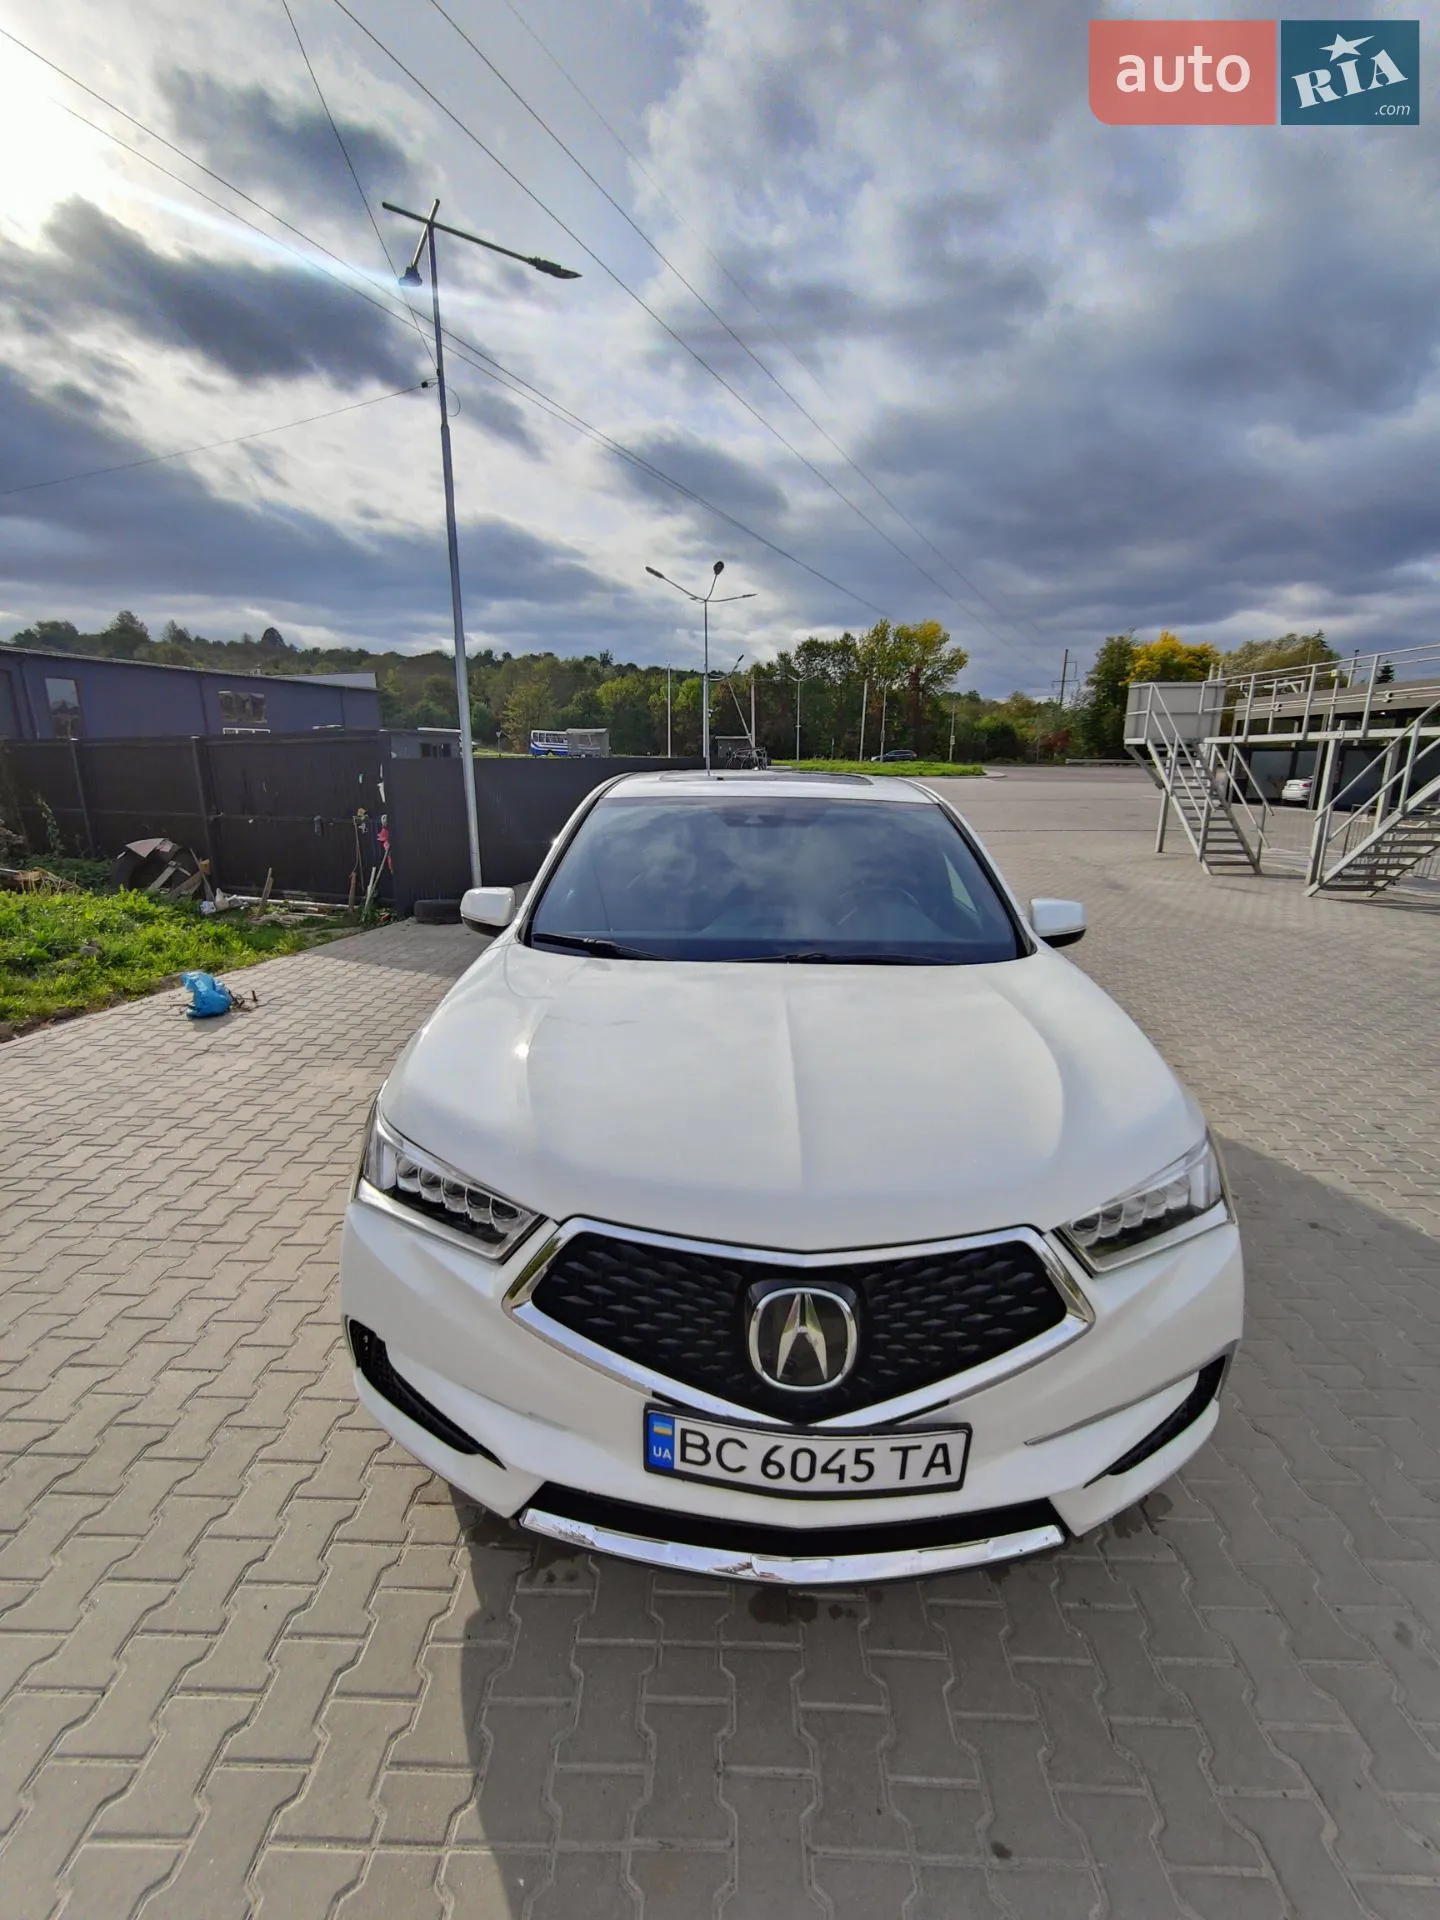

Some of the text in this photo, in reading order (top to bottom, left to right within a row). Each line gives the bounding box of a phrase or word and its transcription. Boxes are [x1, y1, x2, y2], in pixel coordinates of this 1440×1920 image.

[652, 1444, 673, 1461] UA
[680, 1427, 953, 1484] BC 6045 TA
